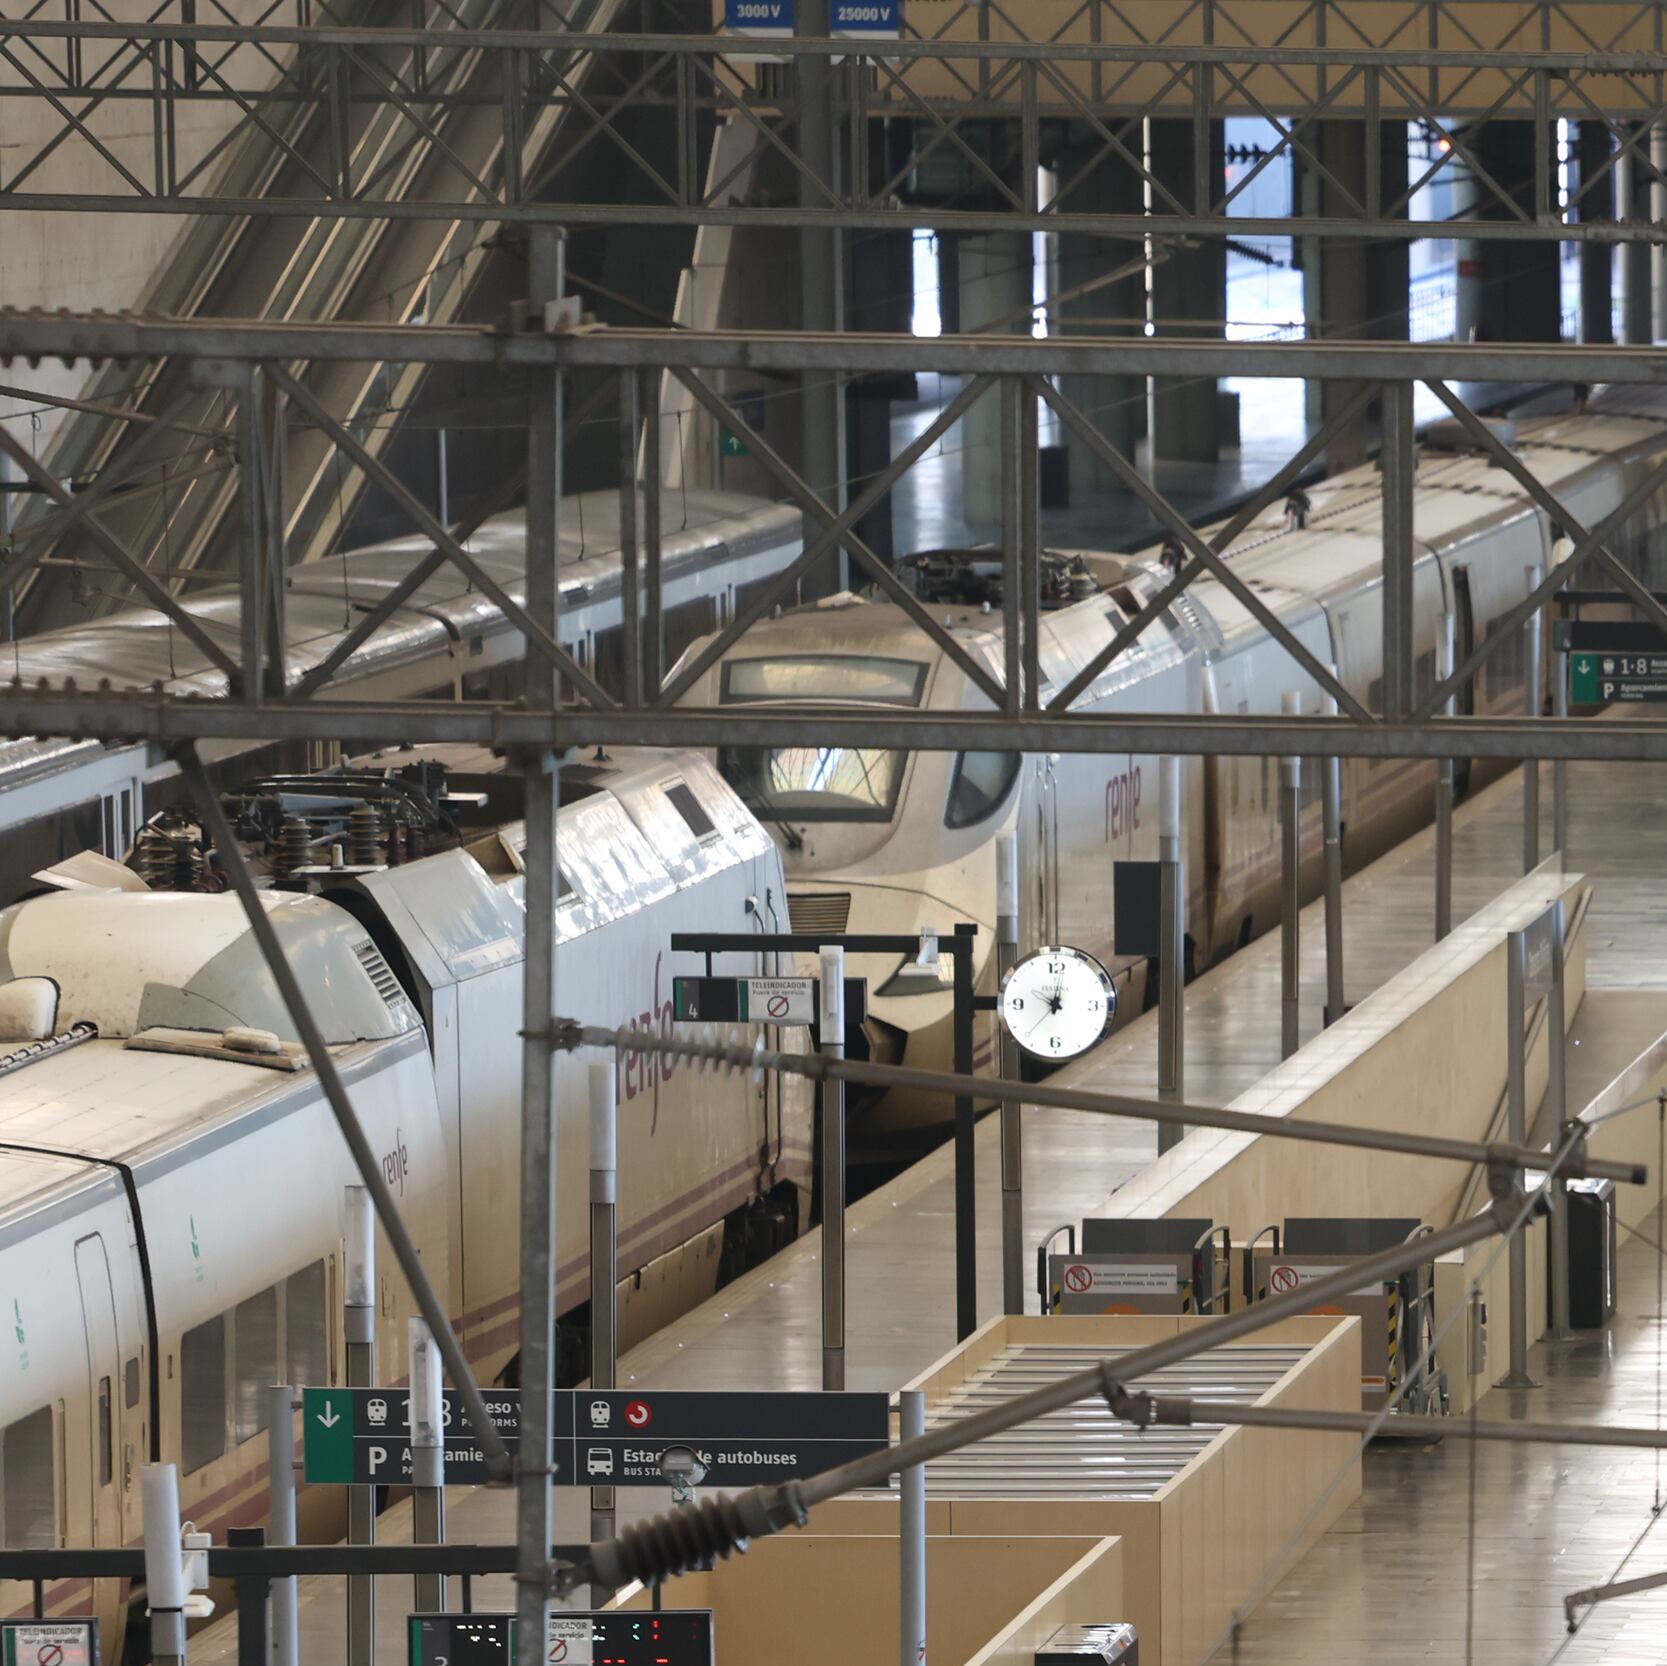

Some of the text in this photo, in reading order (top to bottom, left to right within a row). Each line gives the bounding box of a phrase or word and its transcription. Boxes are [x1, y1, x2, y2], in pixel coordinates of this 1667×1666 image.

[736, 4, 781, 18] 3000 V
[837, 7, 891, 21] 25000 V
[1048, 962, 1065, 975] 12
[688, 1003, 698, 1018] 4
[1011, 998, 1024, 1011] 9
[1088, 999, 1099, 1013] 3
[1049, 1036, 1061, 1051] 6
[369, 1446, 388, 1476] P
[717, 1449, 798, 1465] autobuses
[623, 1466, 643, 1477] BUS
